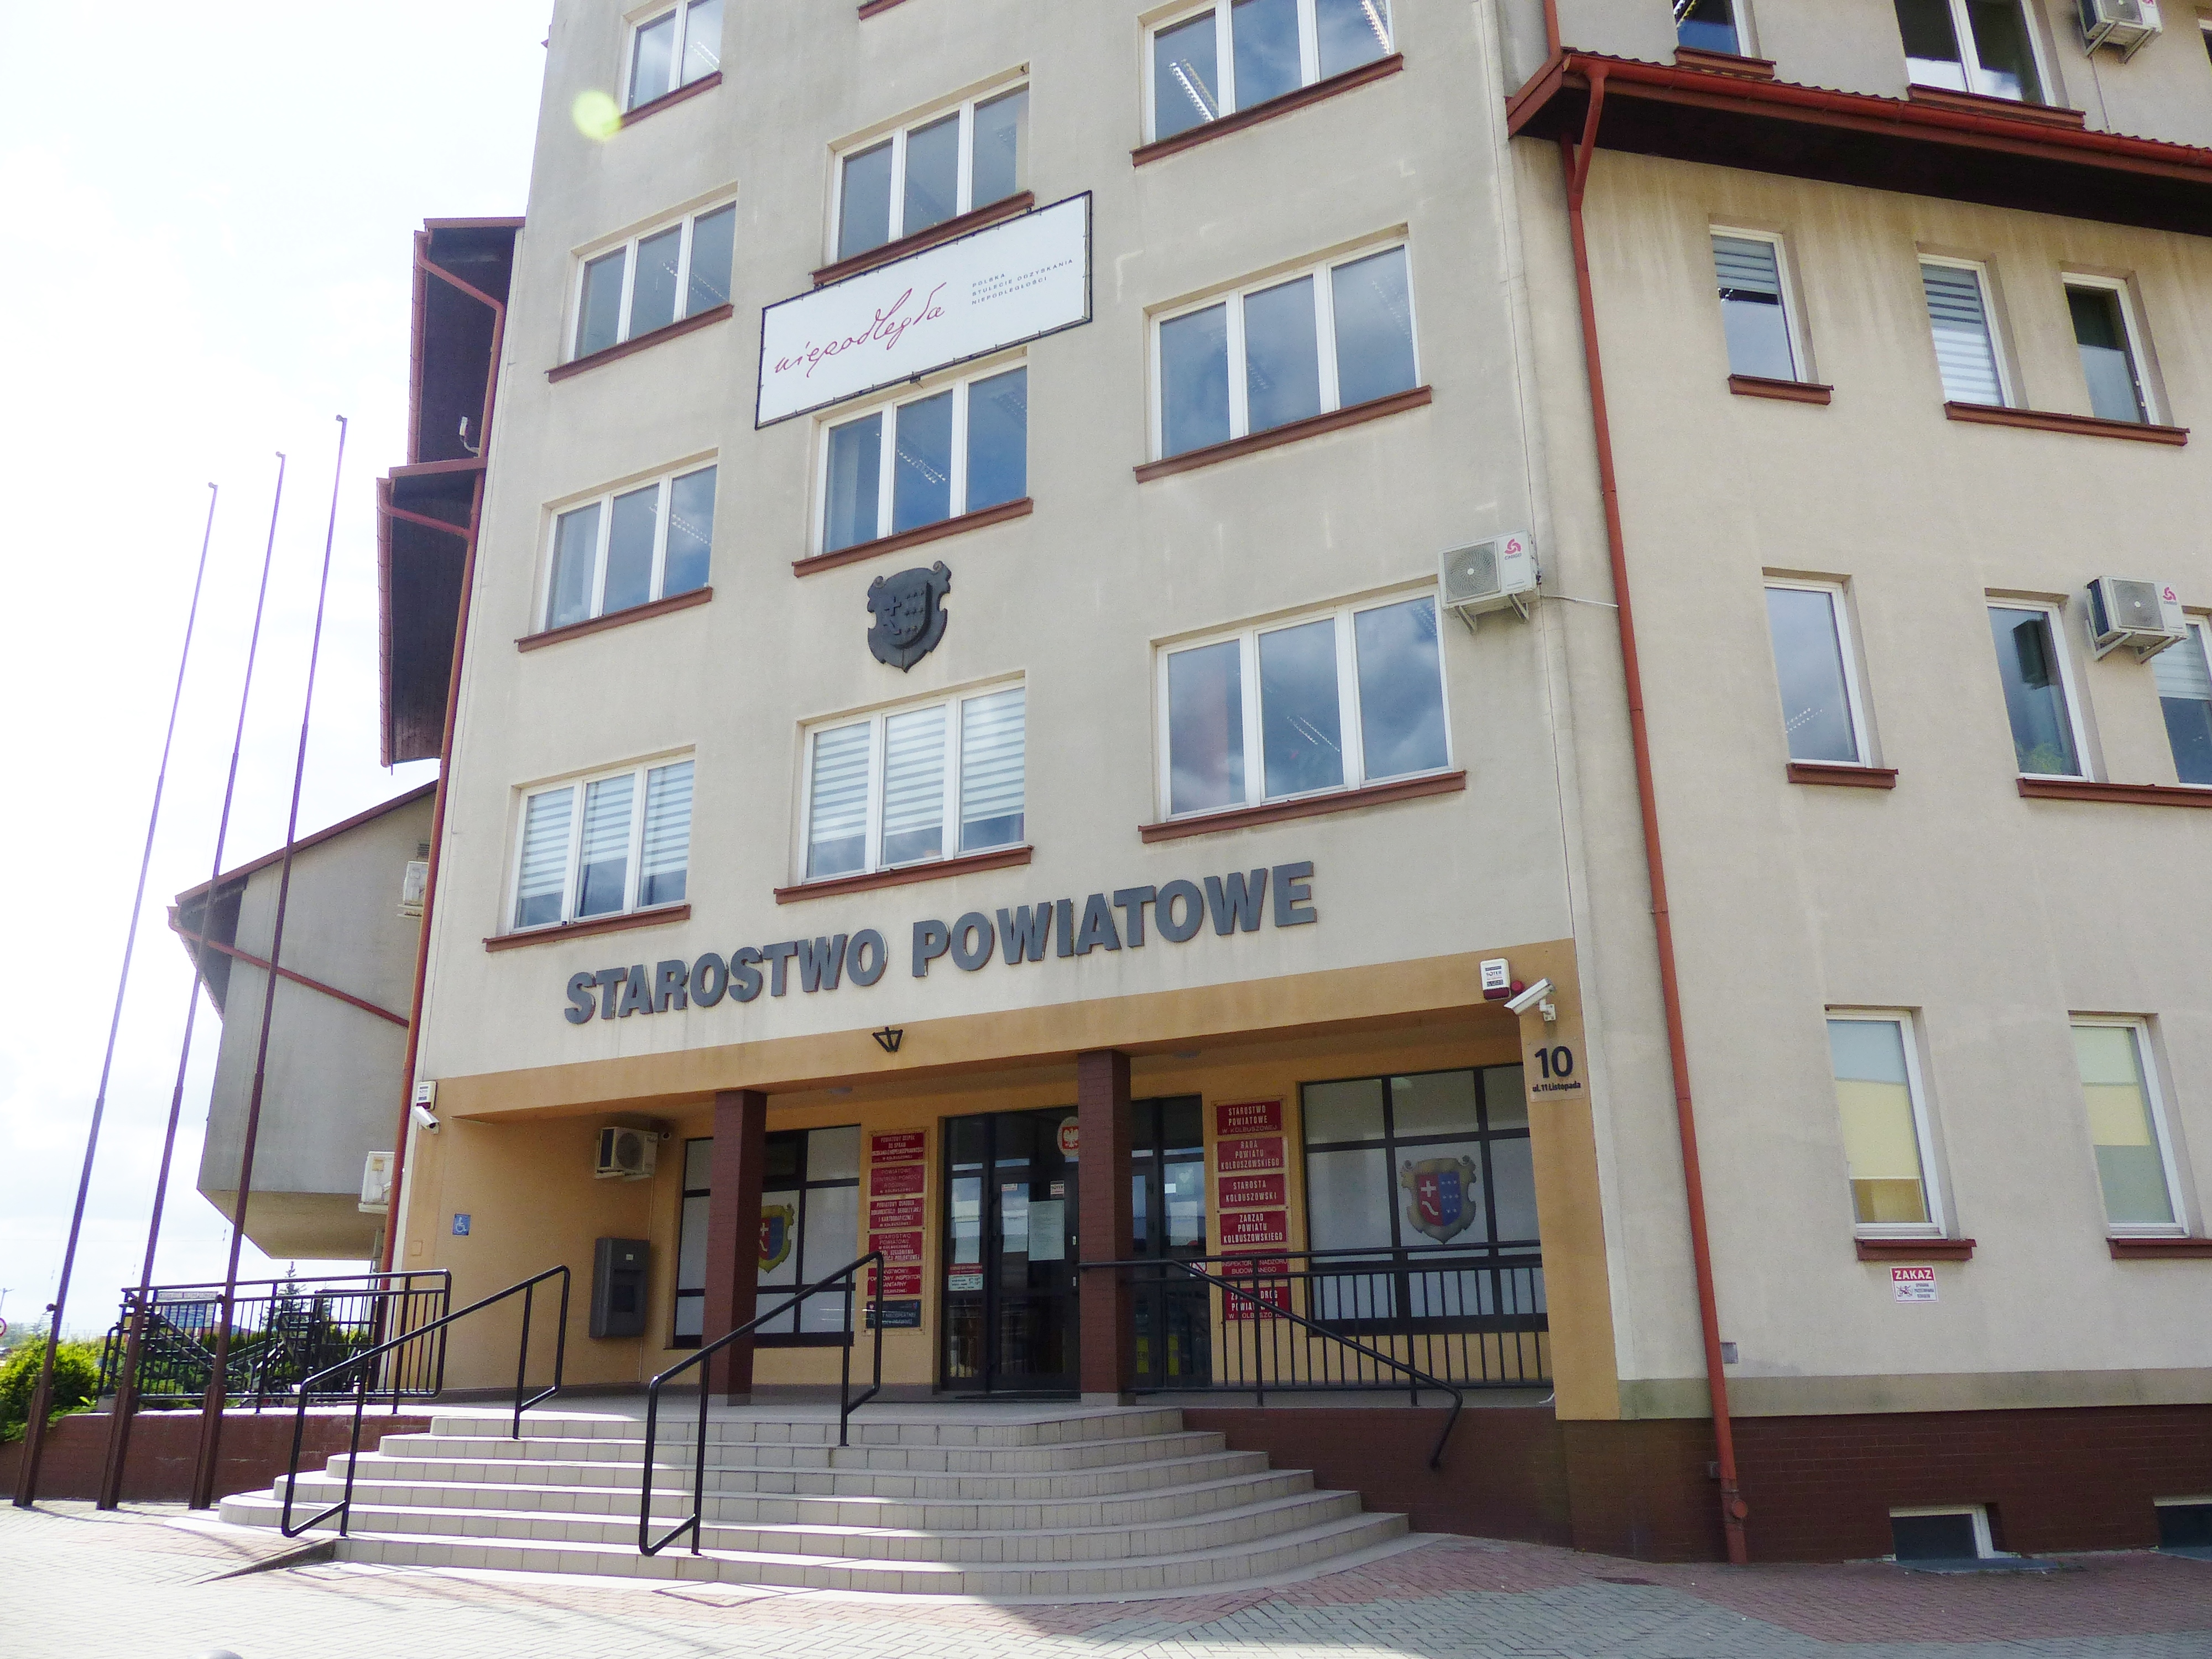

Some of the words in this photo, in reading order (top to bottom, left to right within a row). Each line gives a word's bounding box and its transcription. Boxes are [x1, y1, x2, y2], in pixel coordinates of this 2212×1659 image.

[972, 279, 1013, 296] STULECIE
[1017, 259, 1073, 281] ODZYSKANIA
[972, 273, 1005, 288] POLSKA
[565, 928, 888, 1024] STAROSTWO
[912, 861, 1317, 977] POWIATOWE
[1535, 1046, 1573, 1078] 10
[1549, 1081, 1581, 1091] Listopada
[1229, 1105, 1266, 1115] STAROSTWO
[1228, 1115, 1267, 1126] POWIATOWE
[1230, 1125, 1277, 1133] KOLBUSZOWEJ
[1241, 1140, 1258, 1149] RADA
[1235, 1149, 1264, 1159] POWIATU
[1221, 1158, 1280, 1170] KOLBUSZOWSKIEGO
[1233, 1180, 1266, 1190] STAROSTA
[1226, 1192, 1277, 1202] KOLBUSZOWSKI
[1238, 1223, 1267, 1233] POWIATU
[1223, 1232, 1283, 1243] KOLBUSZOWSKIEGO
[1895, 1270, 1932, 1280] ZAKAZ
